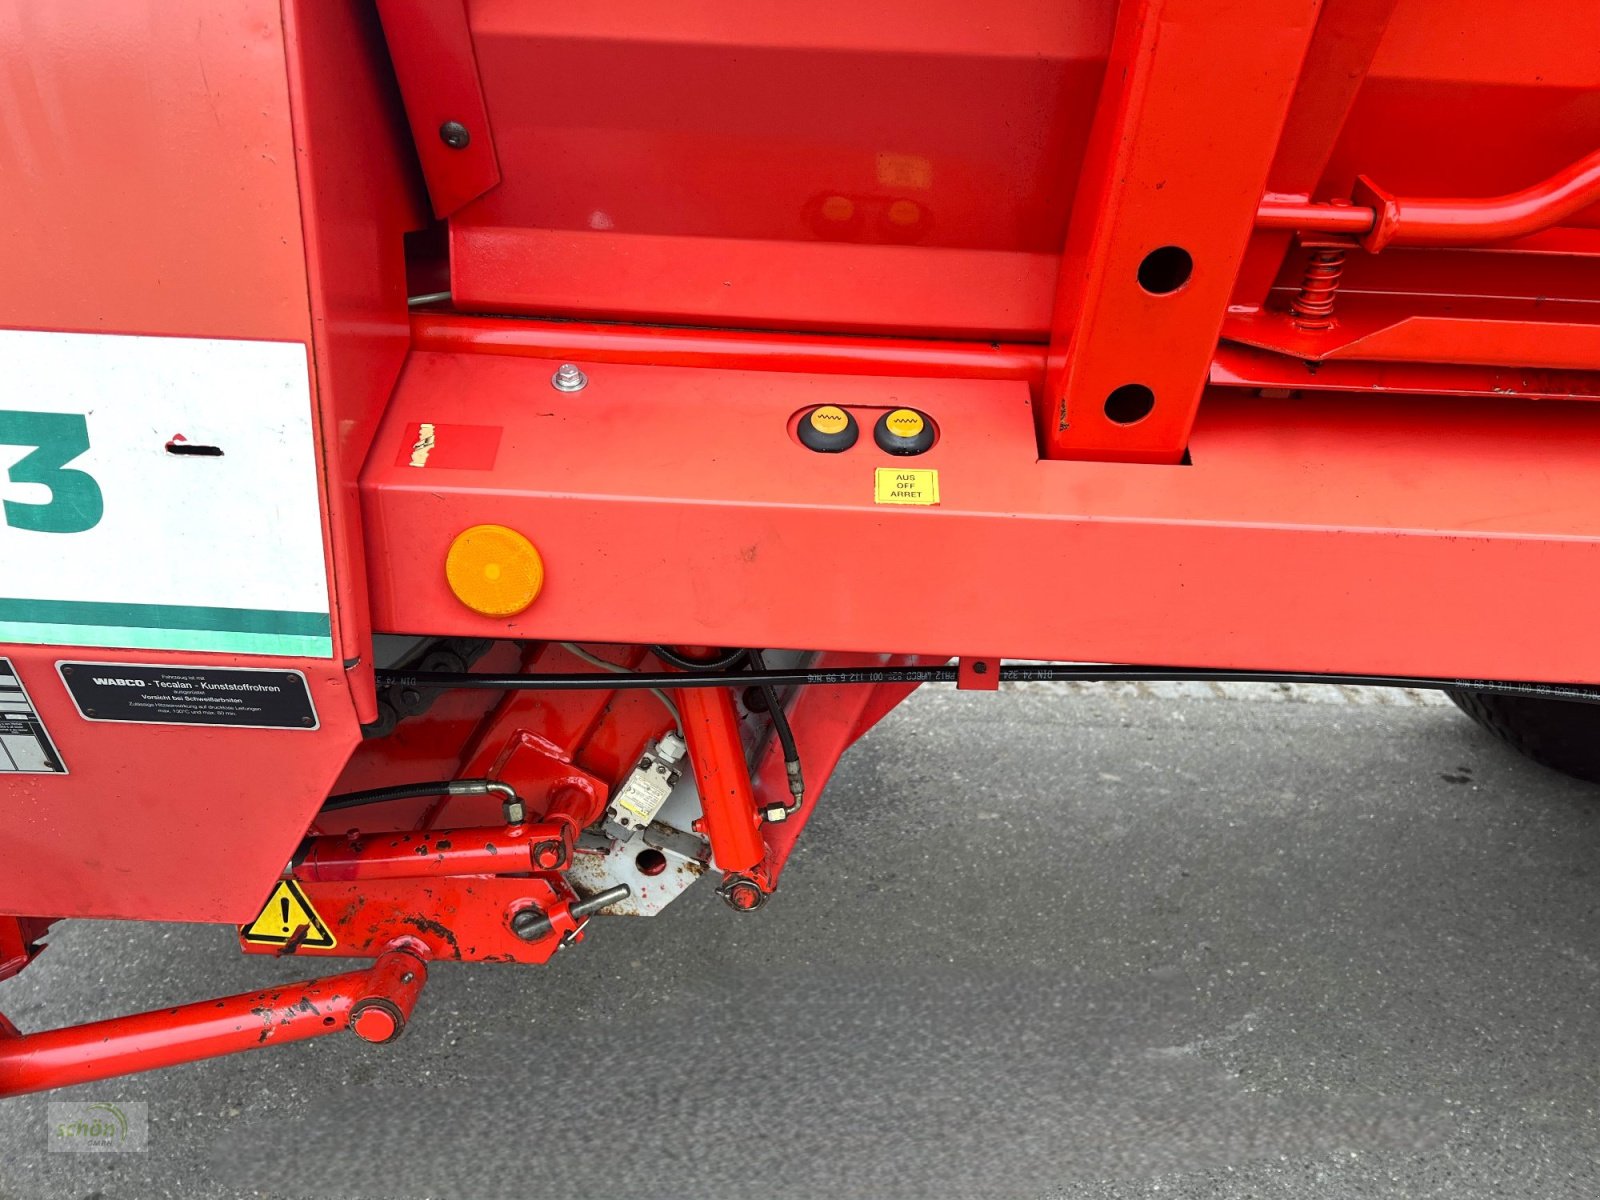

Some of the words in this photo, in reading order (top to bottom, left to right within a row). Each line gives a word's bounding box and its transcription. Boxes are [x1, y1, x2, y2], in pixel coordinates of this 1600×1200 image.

[0, 409, 103, 534] 3
[92, 677, 145, 687] WABCO
[153, 680, 193, 689] Tecalan
[200, 682, 281, 692] Kunststoffrohren
[184, 696, 243, 704] Schweißarbeiten
